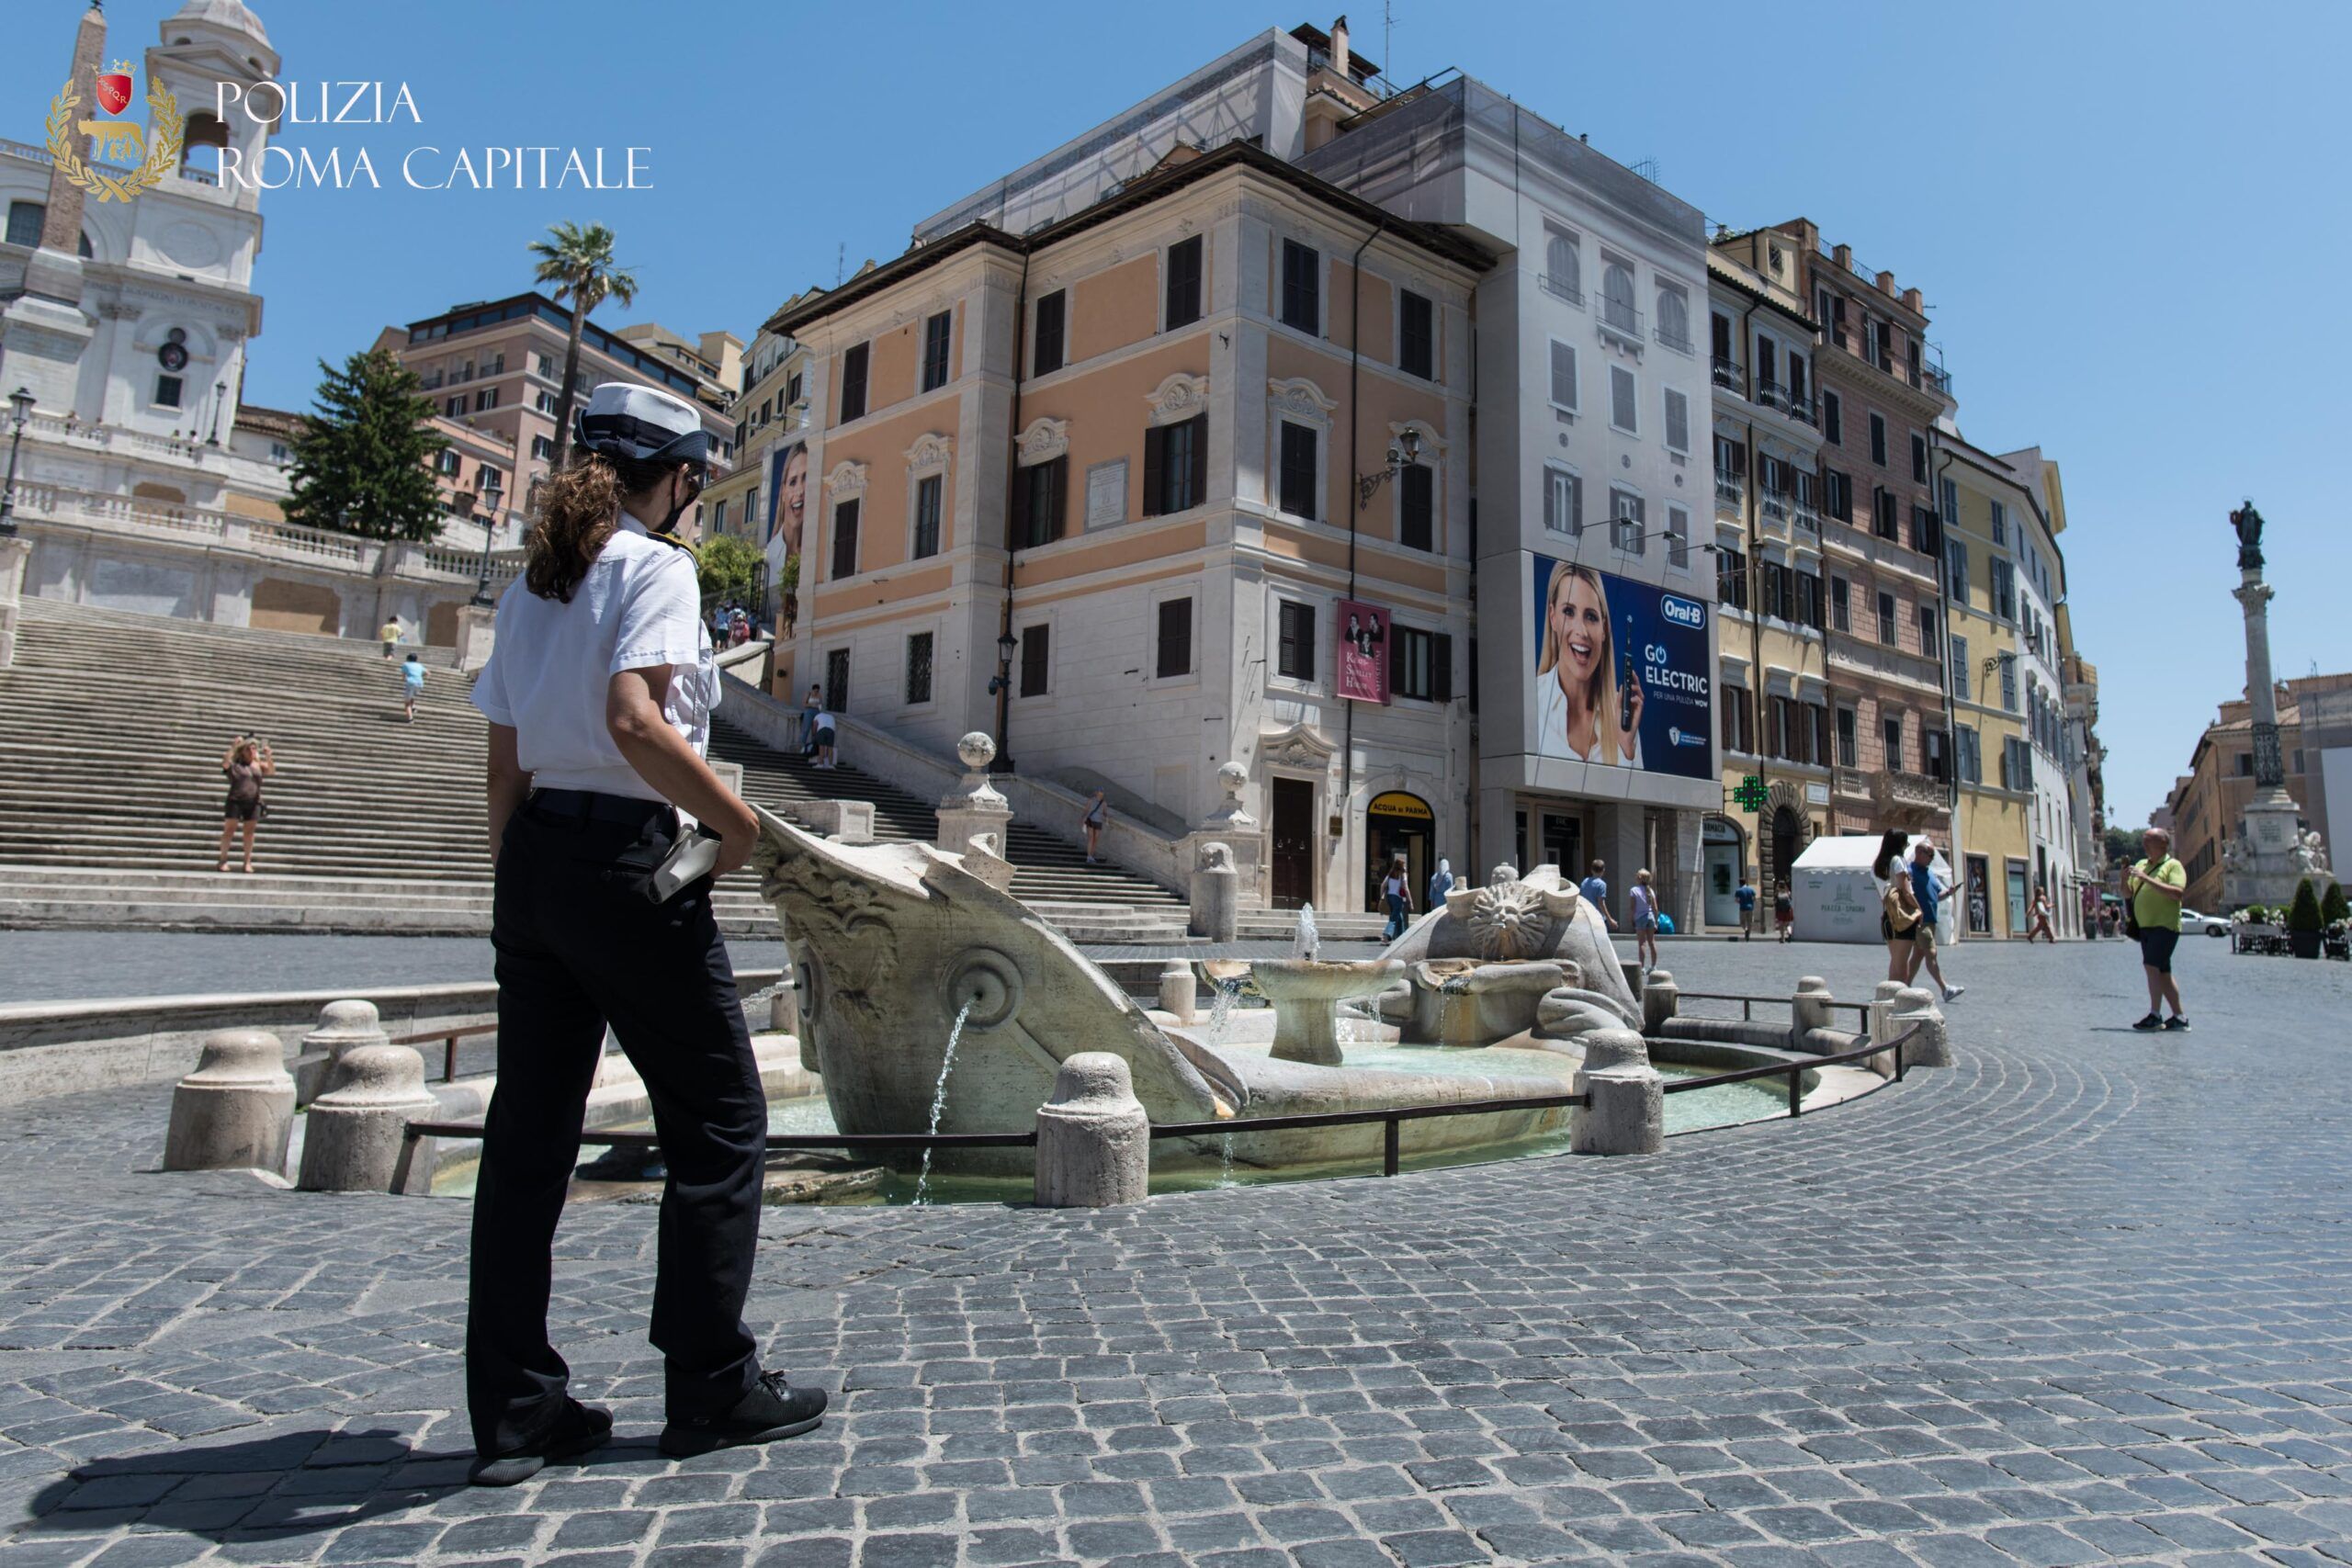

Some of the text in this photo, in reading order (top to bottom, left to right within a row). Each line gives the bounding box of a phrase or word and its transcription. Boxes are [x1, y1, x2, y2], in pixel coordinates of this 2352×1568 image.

[1664, 600, 1701, 624] Oral-B
[1645, 644, 1667, 664] GO
[1645, 665, 1708, 694] ELECTRIC
[1694, 699, 1708, 708] WOW
[1374, 803, 1396, 812] ACQUA
[1406, 807, 1428, 815] PARMA
